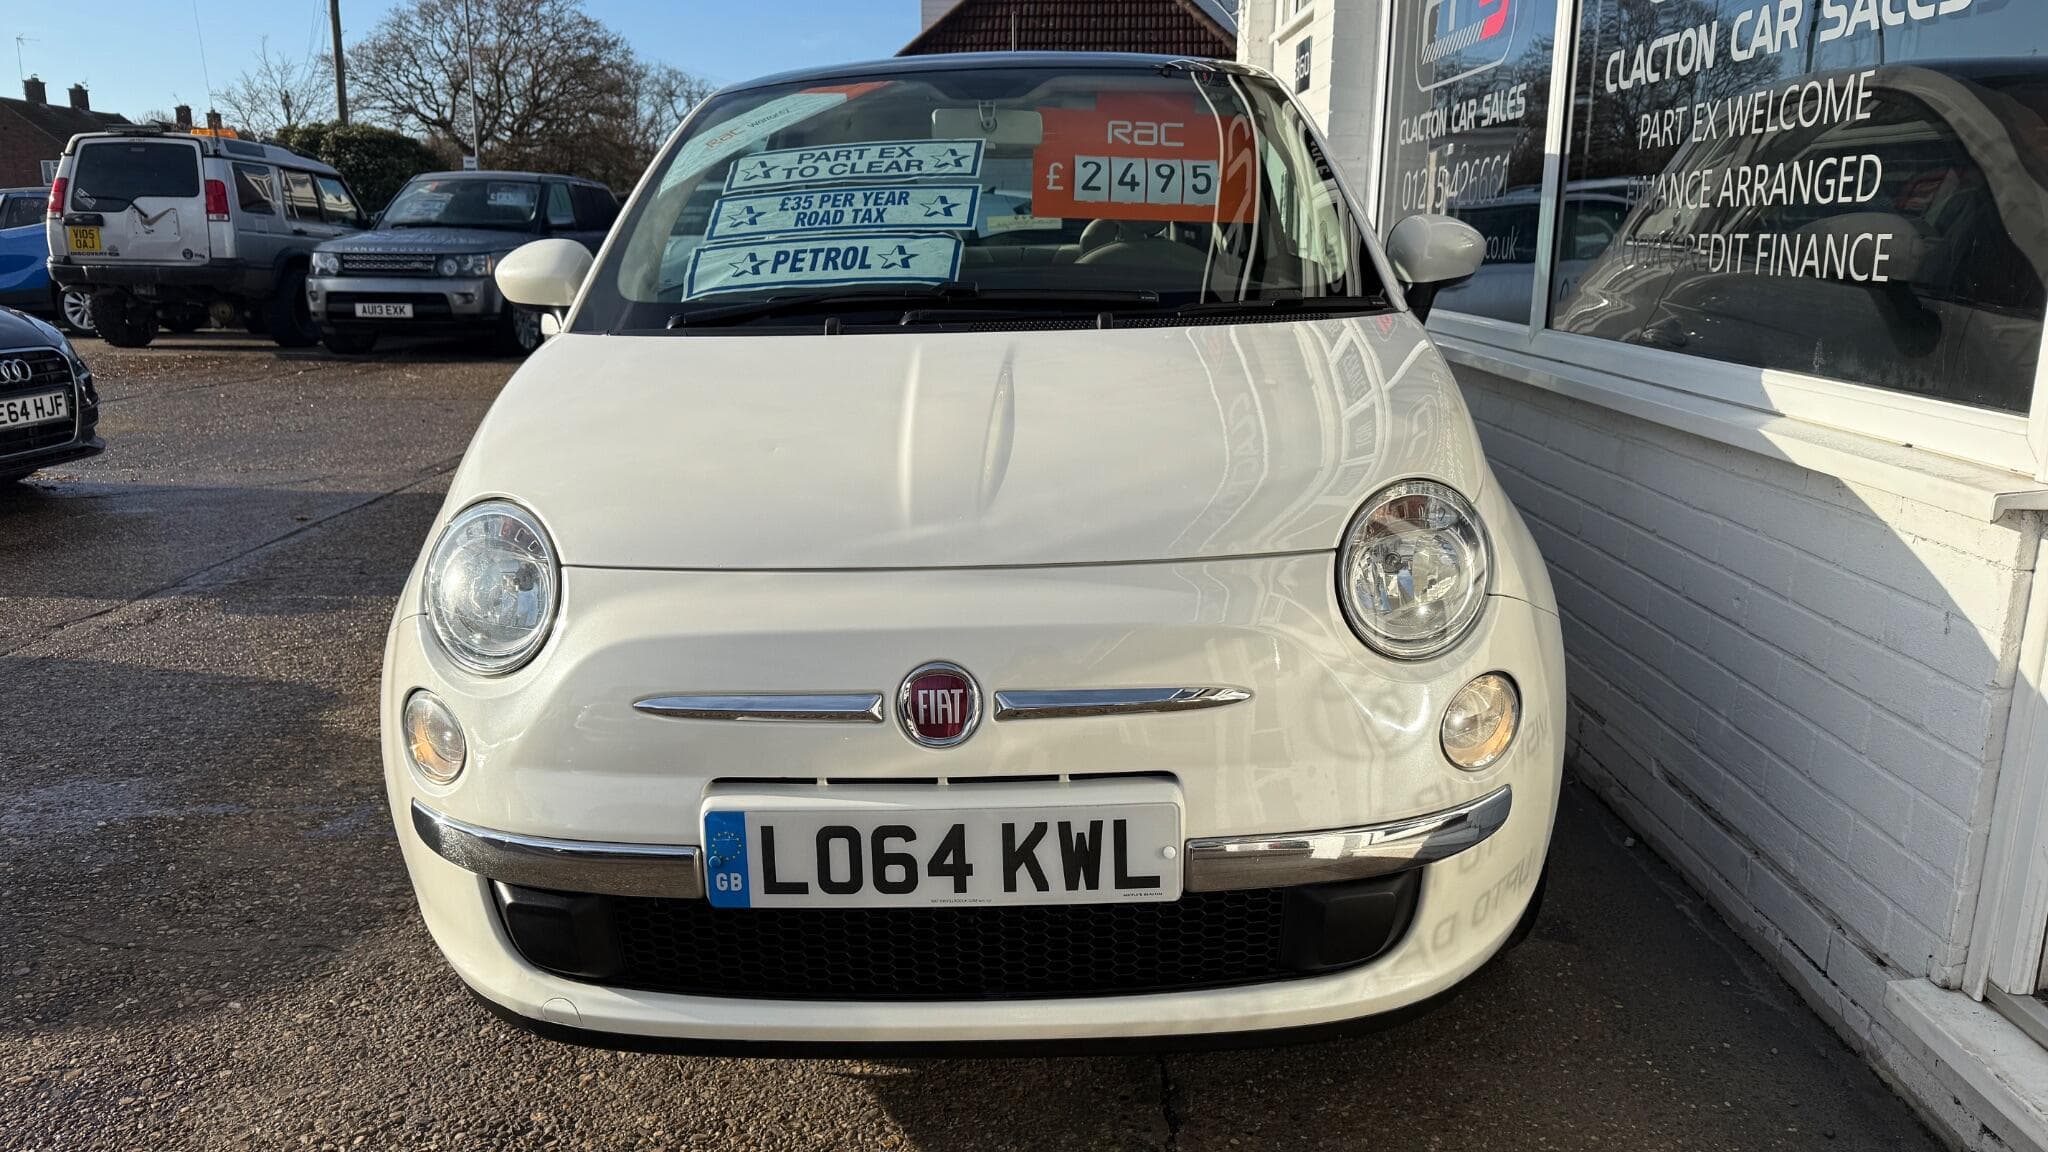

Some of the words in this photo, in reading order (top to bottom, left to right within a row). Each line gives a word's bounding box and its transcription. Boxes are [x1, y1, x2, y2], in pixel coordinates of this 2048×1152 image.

[1605, 20, 1718, 93] CLACTON
[1730, 0, 1802, 62] CAR
[1820, 0, 1972, 43] SAL
[1400, 107, 1448, 146] CLACTON
[1451, 98, 1477, 133] CAR
[1480, 83, 1527, 128] SALES
[1638, 105, 1687, 150] PART
[1692, 99, 1721, 143] EX
[1727, 70, 1876, 137] WELCOME
[782, 166, 820, 180] TO
[828, 159, 924, 176] CLEAR
[797, 147, 870, 164] PART
[877, 146, 915, 159] EX
[1046, 162, 1064, 191] £
[1081, 160, 1212, 195] 2495
[1402, 165, 1446, 211] 0125
[1625, 168, 1713, 212] FINANCE
[1717, 154, 1882, 208] ARRANGED
[778, 195, 813, 212] £35
[818, 193, 856, 209] PER
[862, 191, 910, 207] YEAR
[793, 209, 845, 227] ROAD
[851, 207, 888, 224] TAX
[770, 245, 872, 274] PETROL
[1669, 233, 1749, 274] CREDIT
[1755, 232, 1893, 283] FINANCE
[361, 304, 384, 315] AU13
[386, 304, 406, 315] EXK
[33, 394, 63, 419] HJF
[917, 688, 964, 726] FIAT
[760, 823, 974, 896] LO64
[1001, 818, 1161, 894] KWL
[715, 873, 743, 892] GB
